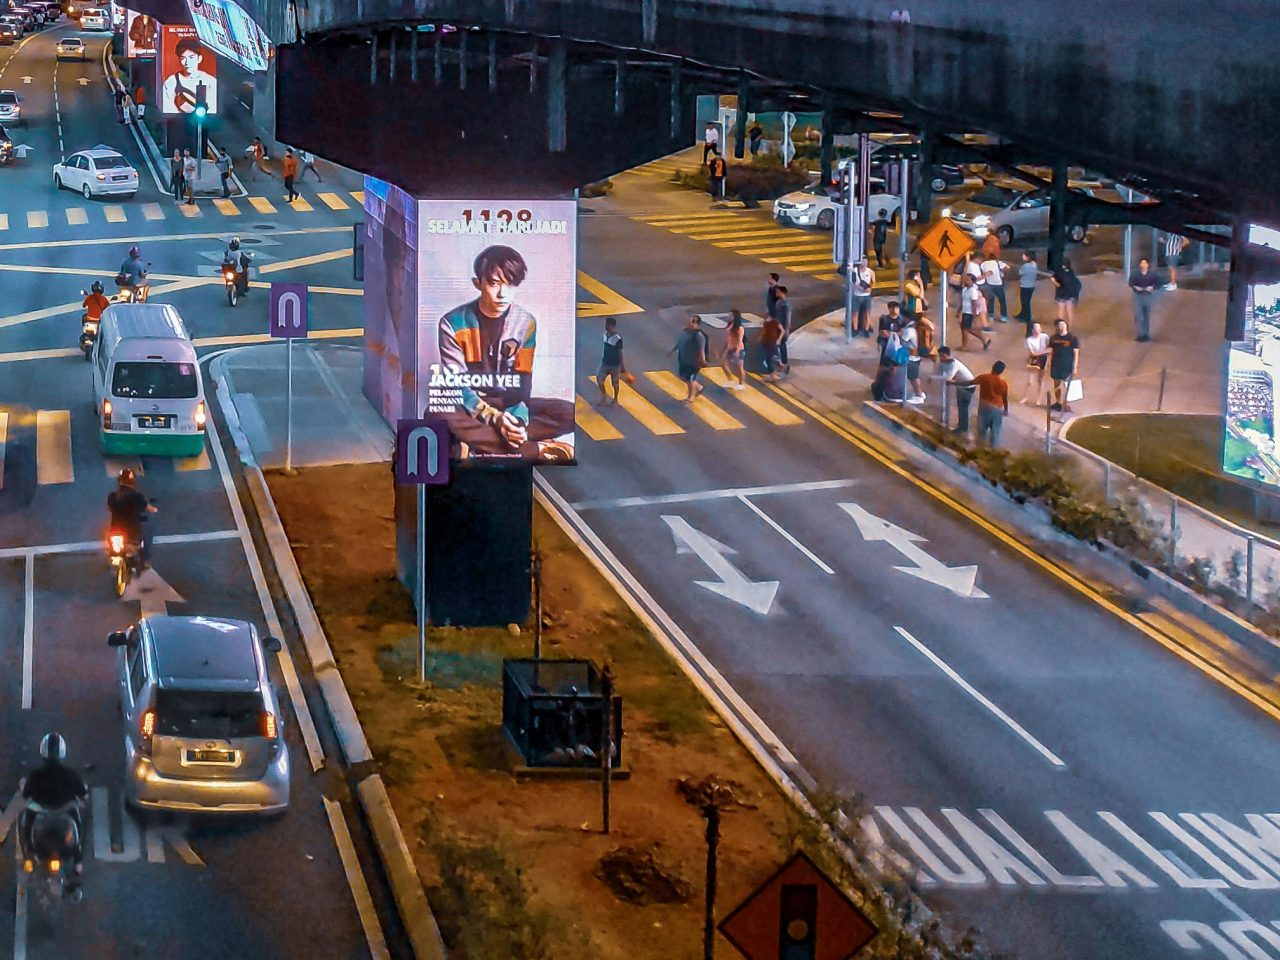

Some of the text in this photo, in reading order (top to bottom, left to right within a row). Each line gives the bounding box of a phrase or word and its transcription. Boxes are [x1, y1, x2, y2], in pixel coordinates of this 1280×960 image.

[428, 219, 492, 234] SELAMAT
[428, 374, 521, 388] JACKSON YEE
